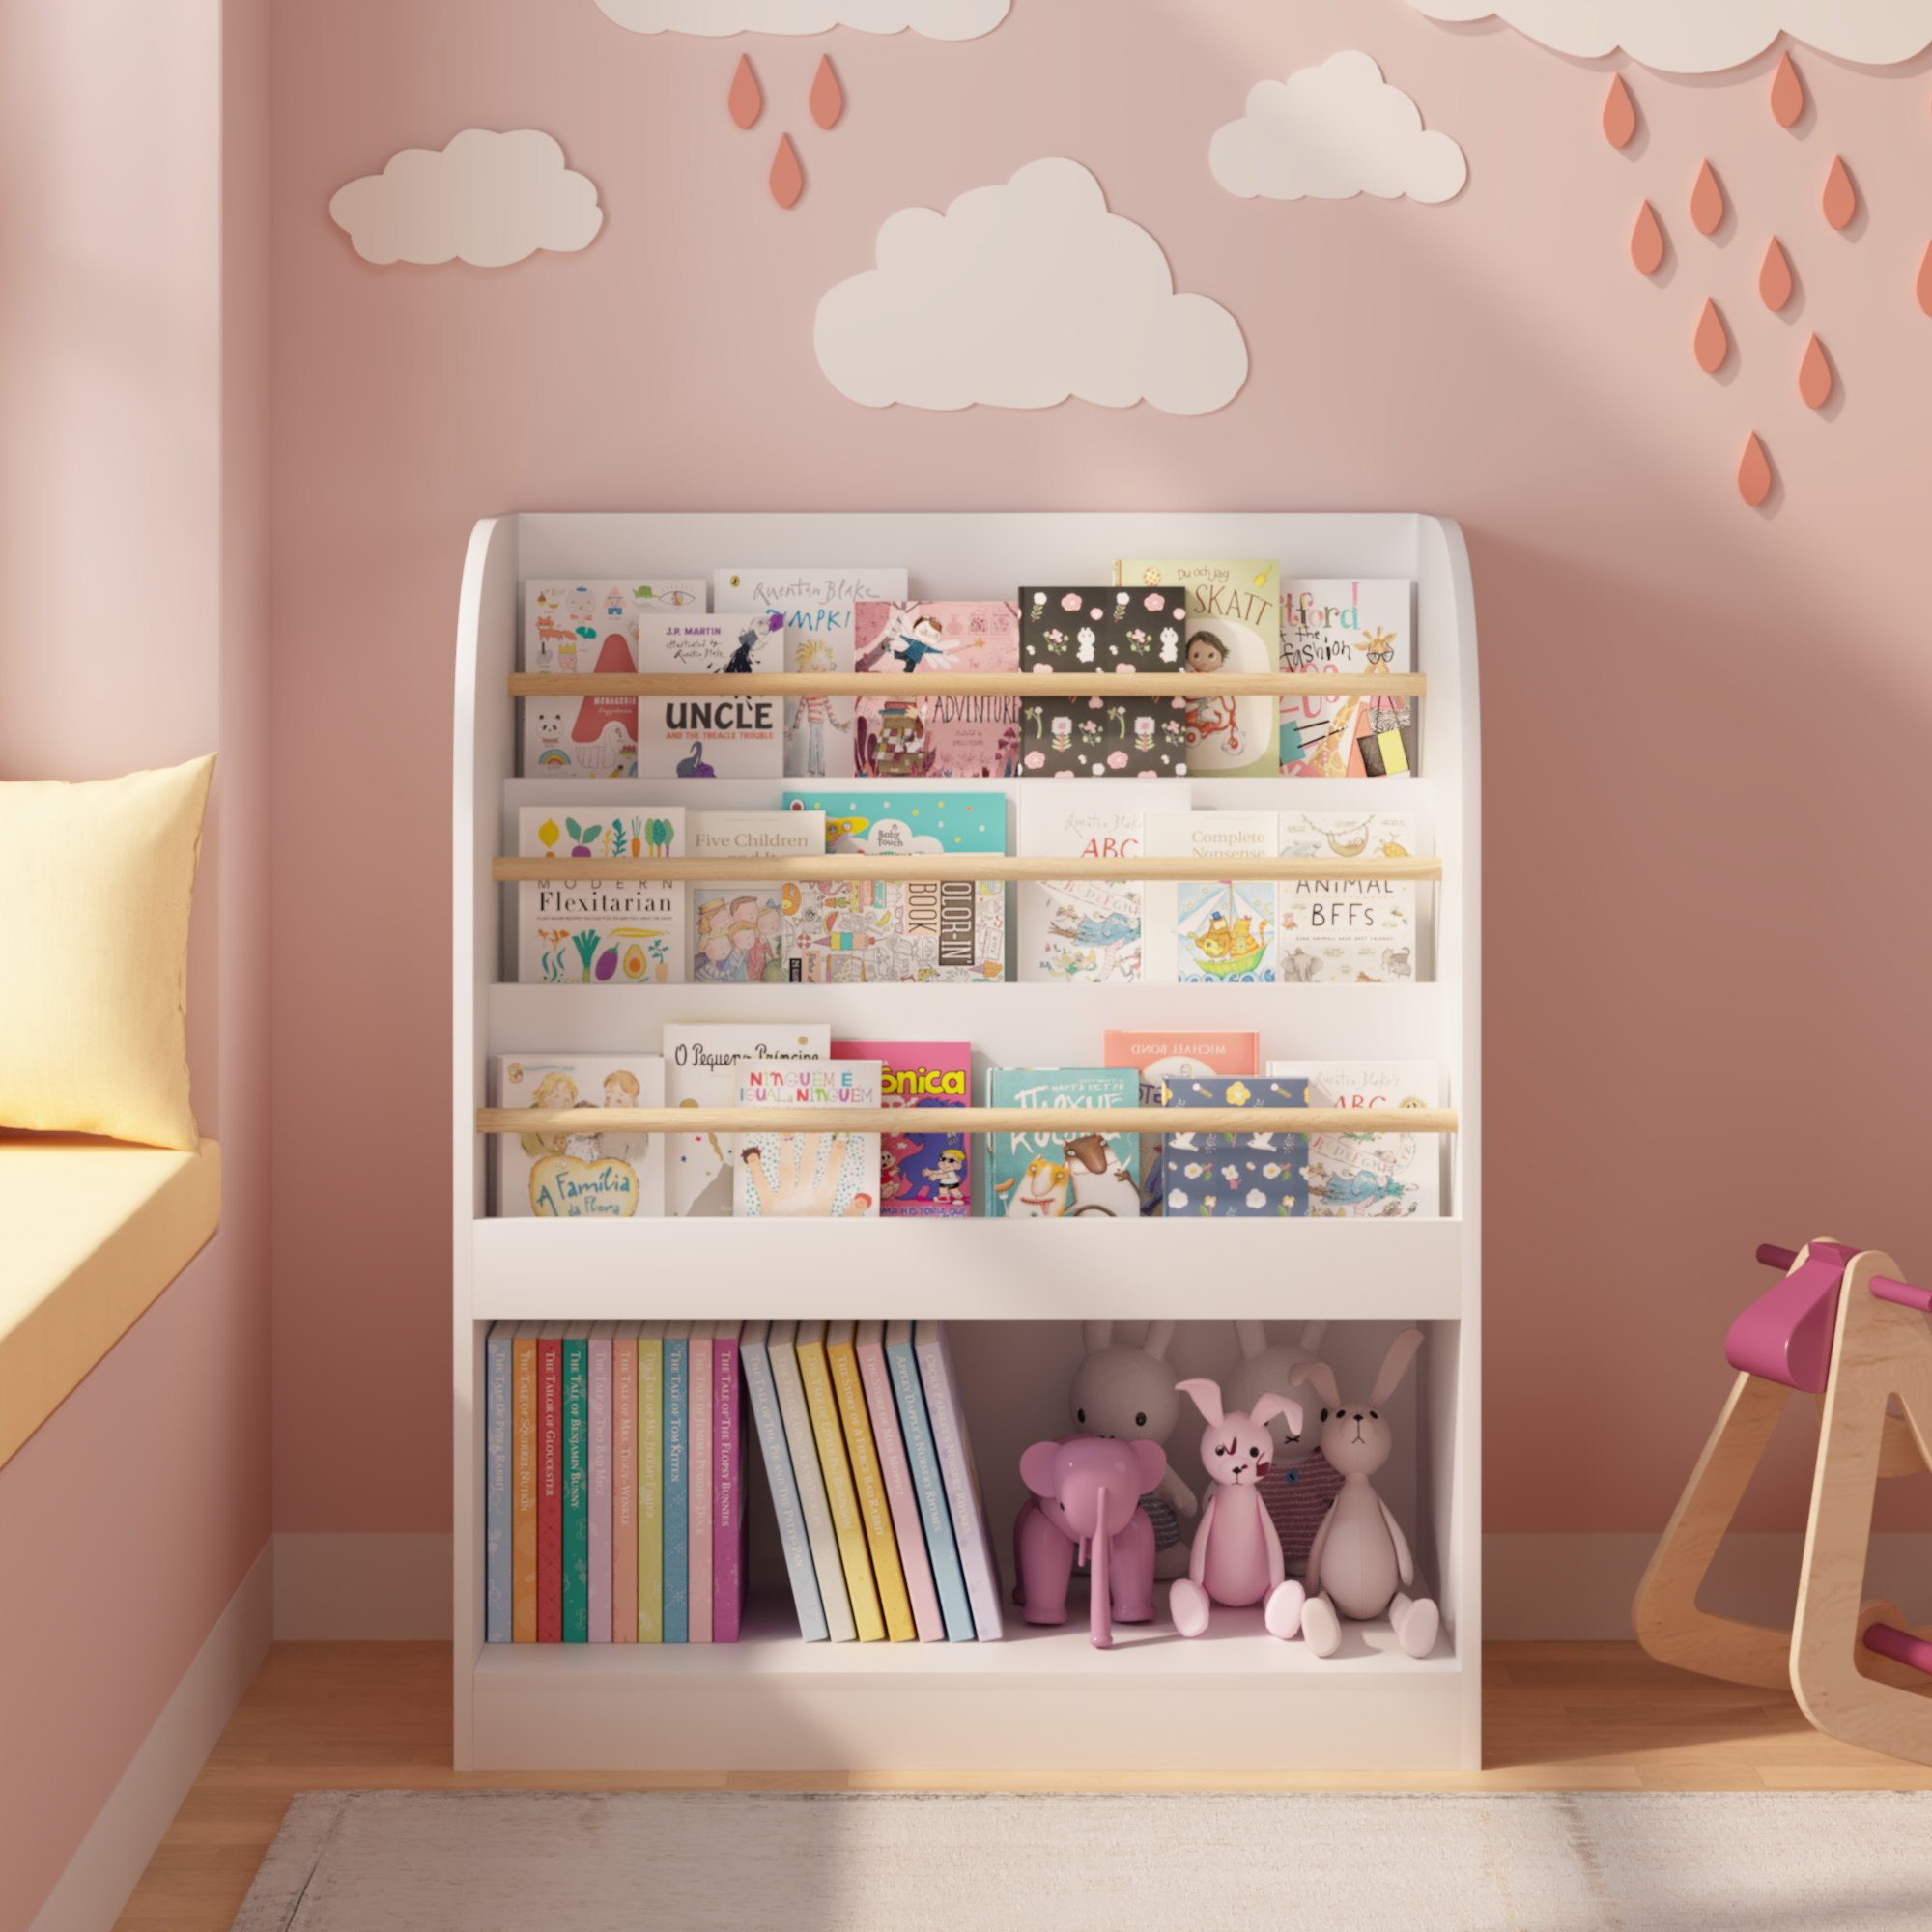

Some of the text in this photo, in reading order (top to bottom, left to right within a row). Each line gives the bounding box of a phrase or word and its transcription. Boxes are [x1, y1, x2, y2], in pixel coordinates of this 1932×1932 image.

[1177, 566, 1230, 582] Du och jag
[818, 578, 880, 605] Blake
[1193, 584, 1273, 626] SKATT
[766, 609, 851, 631] MPKI
[684, 627, 722, 636] MARTIN
[1294, 626, 1320, 642] the
[1280, 636, 1351, 673] fashion
[666, 702, 773, 729] UNCLE
[695, 833, 809, 848] Five Children
[876, 838, 903, 847] Touch
[878, 830, 900, 840] Baby
[1191, 831, 1265, 846] Complete
[1081, 838, 1139, 858] ABC
[1192, 847, 1265, 858] Nonsense
[537, 880, 673, 890] MODERN
[1296, 880, 1394, 894] ANIMAL
[538, 891, 672, 913] Flexitarian
[908, 883, 937, 933] BOOK
[674, 1043, 688, 1066] O
[881, 1066, 966, 1094] ônica
[740, 1087, 786, 1102] IGUAL
[1334, 1094, 1386, 1108] ABC
[536, 1166, 630, 1217] A Família
[568, 1195, 620, 1217] da Flora
[545, 1351, 555, 1373] THE
[570, 1351, 581, 1373] THE
[670, 1351, 681, 1373] THE
[721, 1350, 731, 1373] THE
[570, 1375, 581, 1402] TALE
[670, 1376, 681, 1402] TALE
[721, 1376, 731, 1401] TALE
[570, 1404, 581, 1415] OF
[670, 1404, 681, 1415] OF
[721, 1404, 731, 1415] OF
[545, 1415, 555, 1428] OF
[721, 1418, 731, 1439] THE
